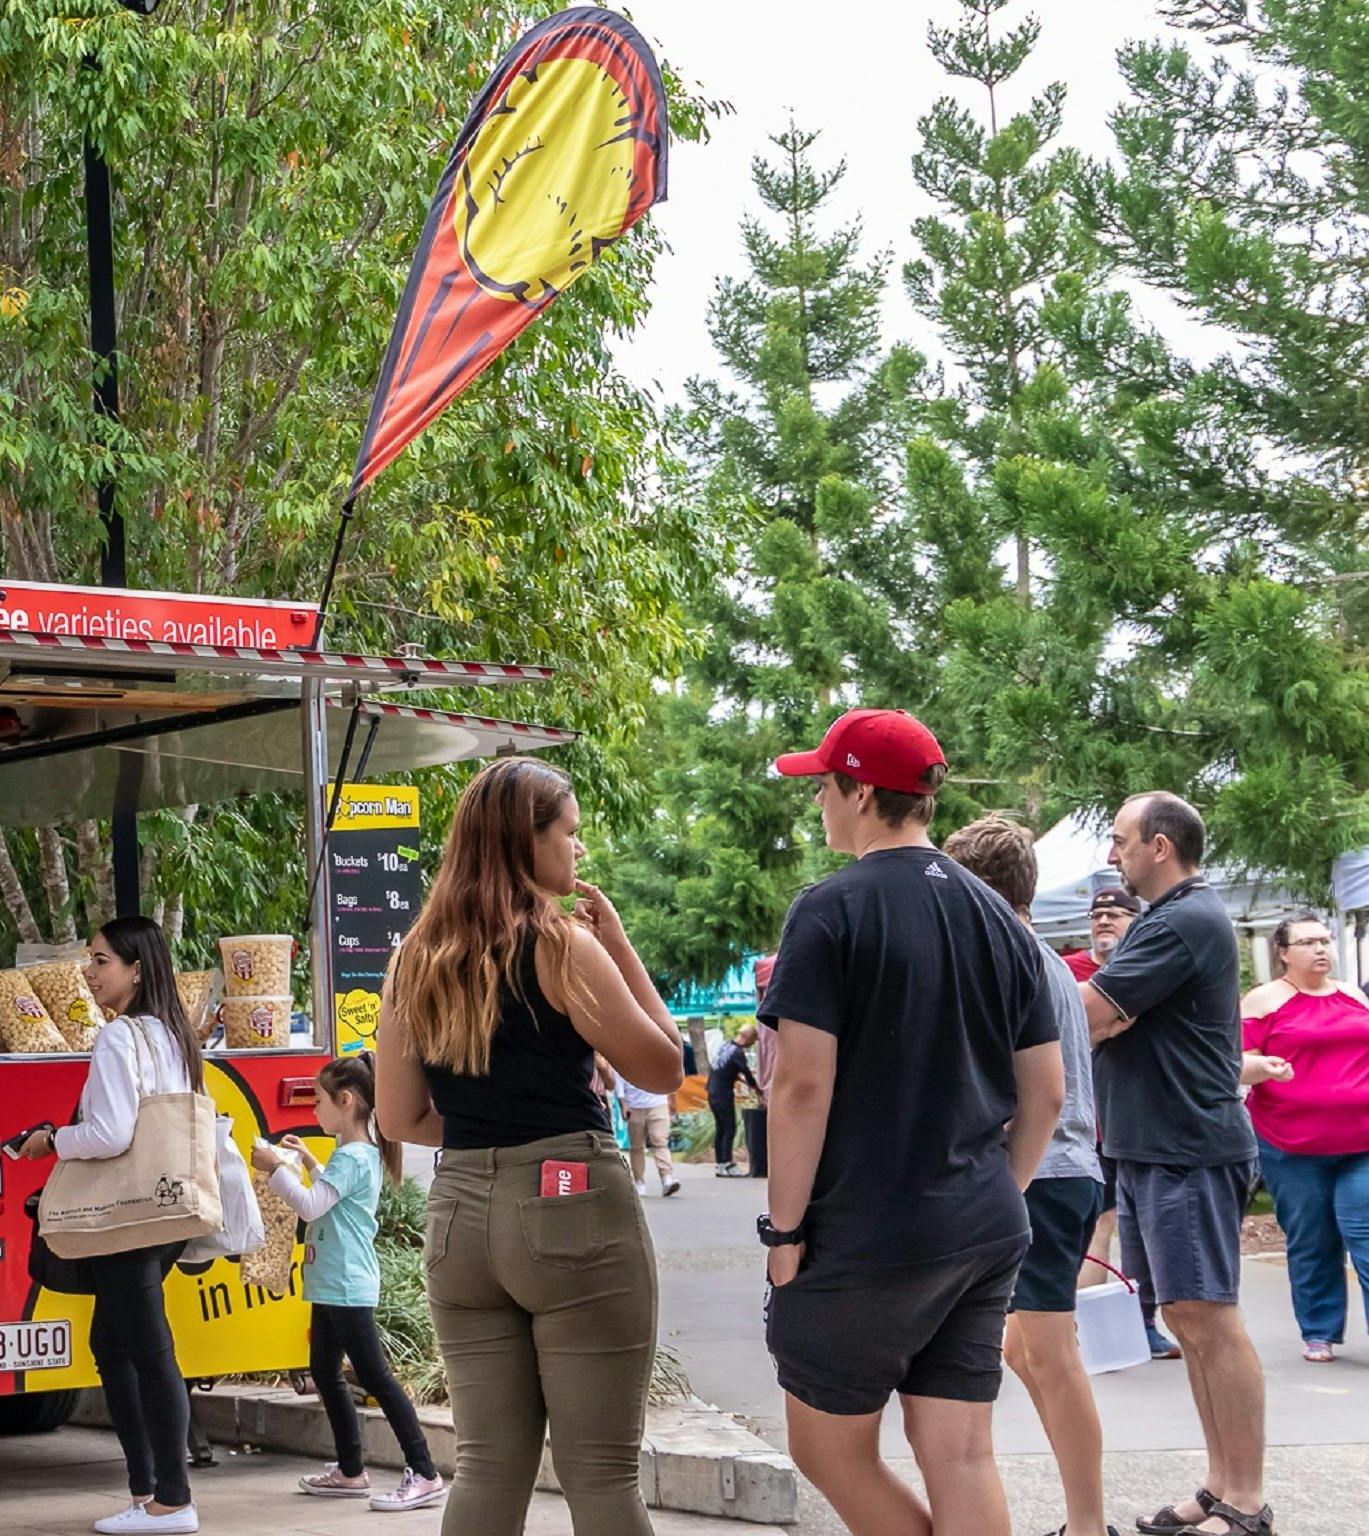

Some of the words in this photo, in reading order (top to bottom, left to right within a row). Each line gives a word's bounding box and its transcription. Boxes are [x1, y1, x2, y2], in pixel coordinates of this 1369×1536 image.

[38, 606, 153, 641] varieties
[163, 617, 277, 650] available
[385, 798, 412, 815] Man
[334, 854, 369, 867] Buckets
[336, 893, 358, 908] Bags
[338, 934, 360, 949] Cups
[341, 1003, 367, 1017] Sweet
[355, 1013, 375, 1025] Salty
[197, 1277, 233, 1322] in
[48, 1358, 66, 1366] STATE
